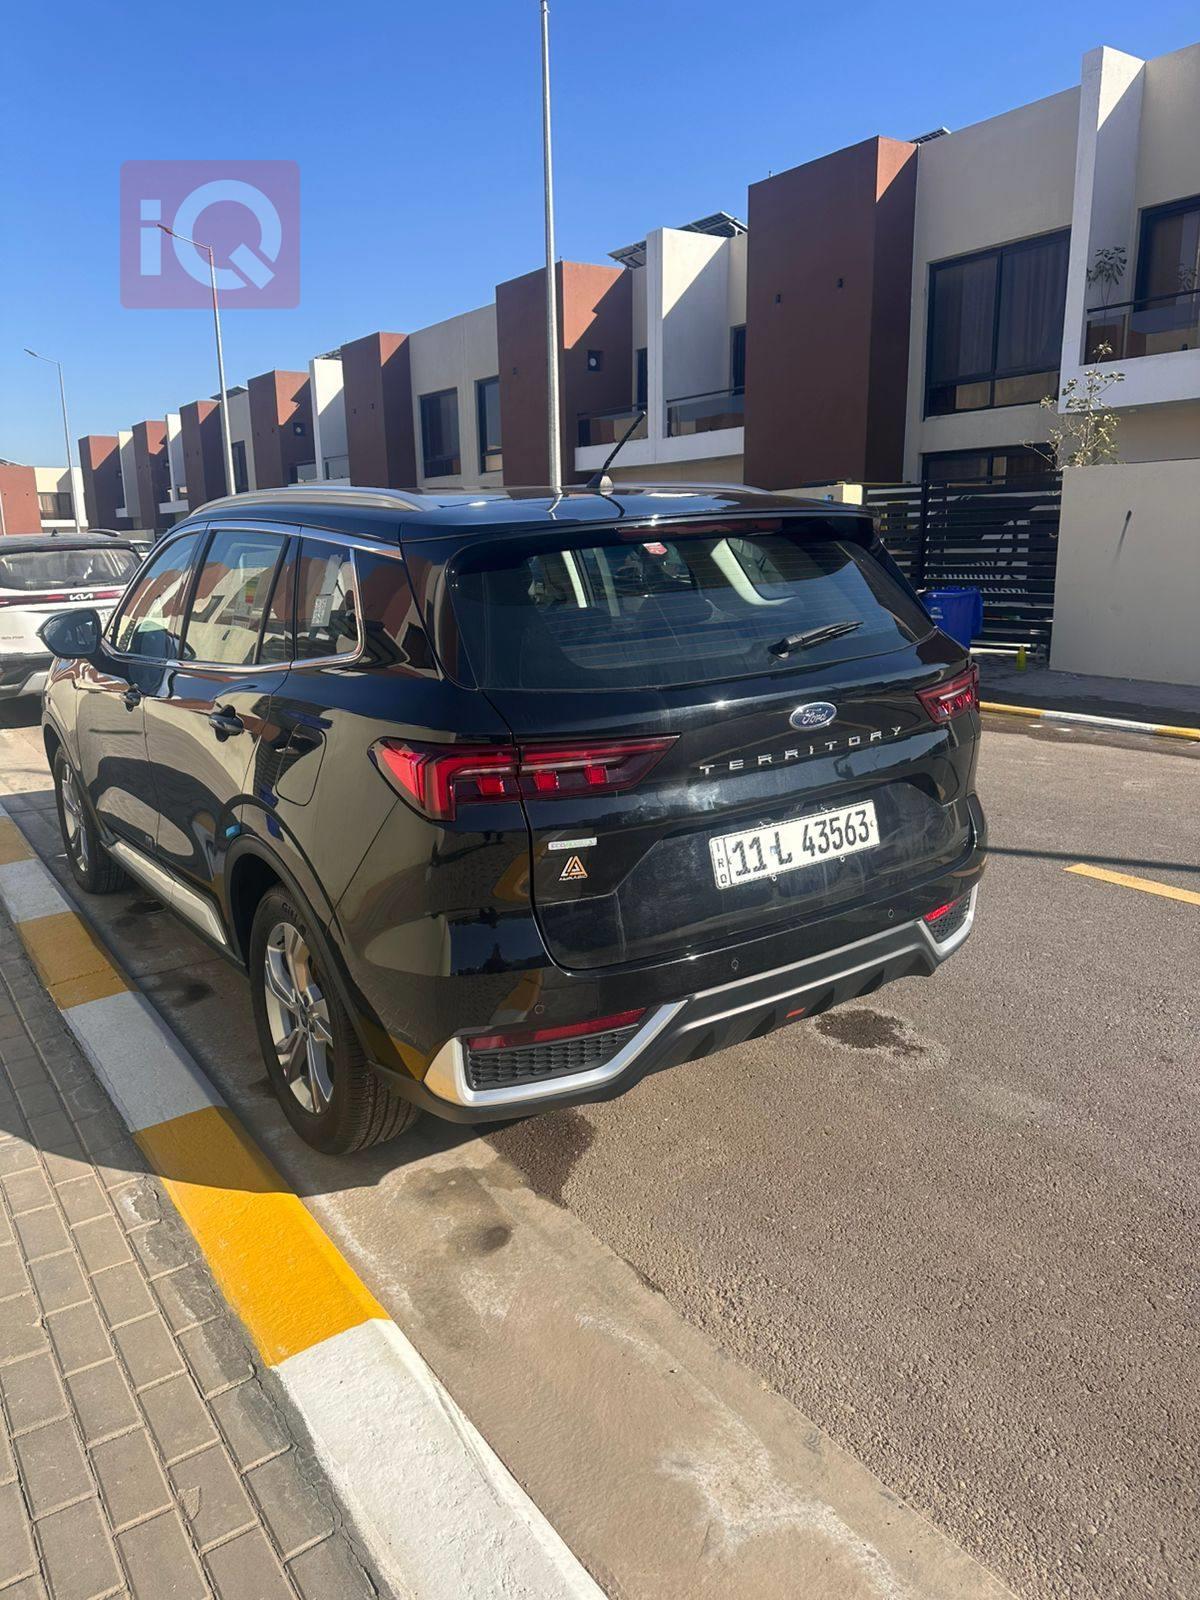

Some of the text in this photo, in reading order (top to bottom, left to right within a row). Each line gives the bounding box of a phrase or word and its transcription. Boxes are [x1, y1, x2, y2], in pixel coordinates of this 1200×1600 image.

[69, 592, 94, 601] KIA
[801, 710, 829, 725] Ford
[699, 726, 901, 776] TERRITORY
[731, 809, 870, 877] 11 L 43563
